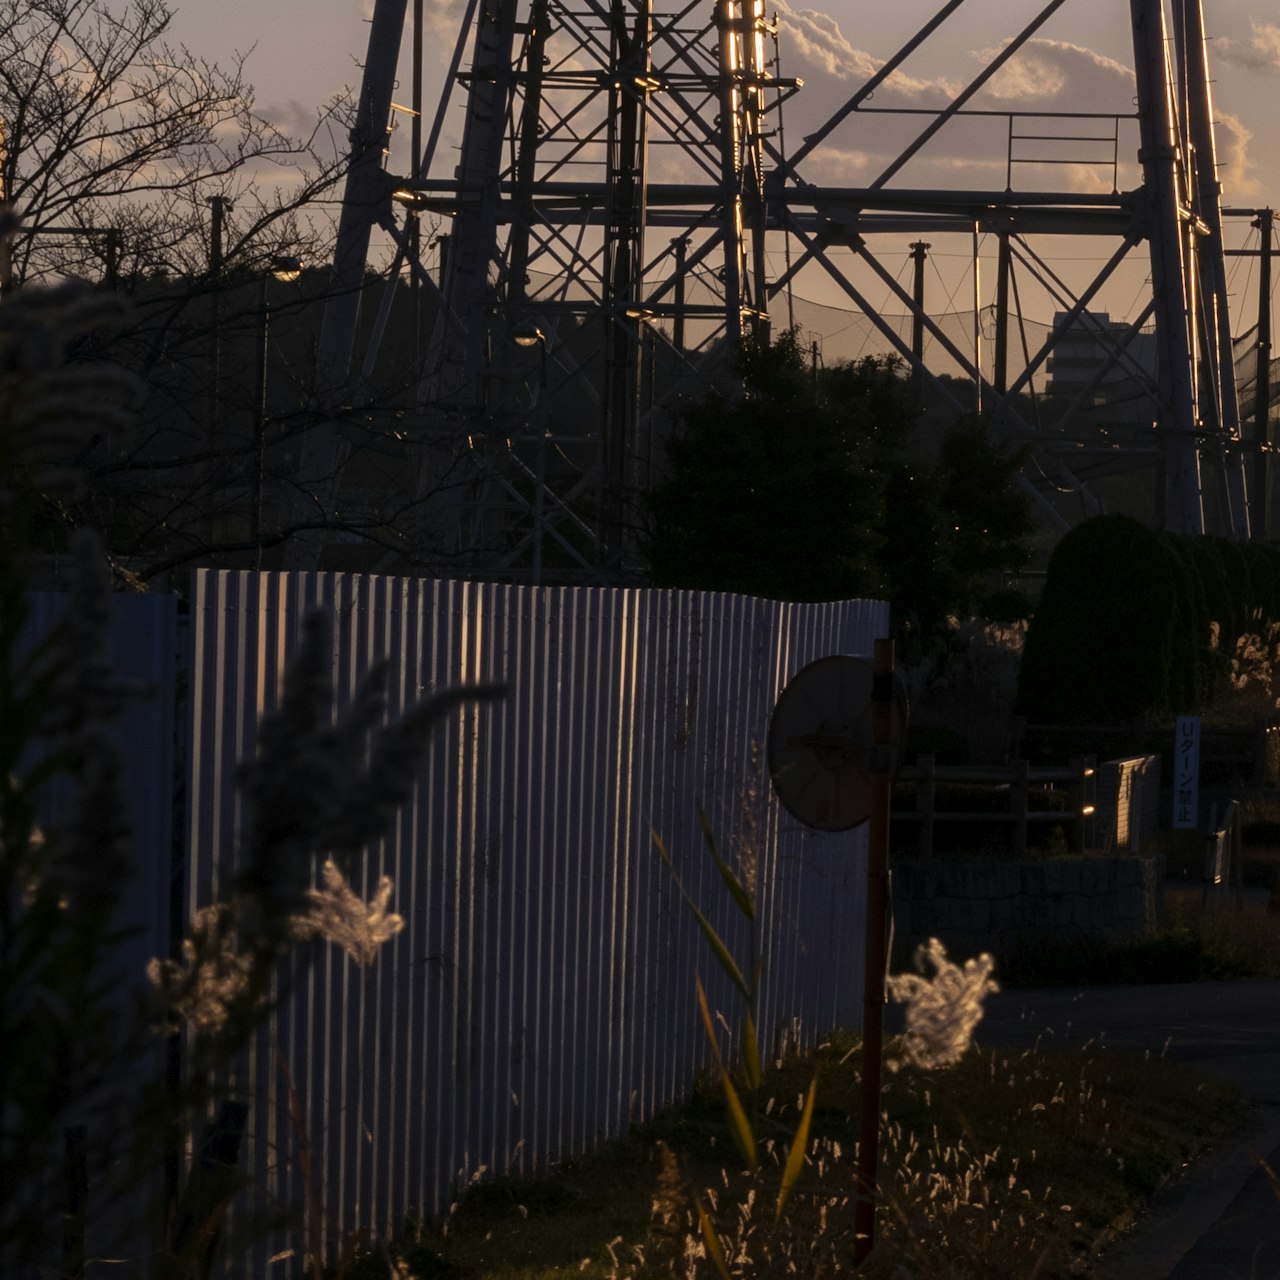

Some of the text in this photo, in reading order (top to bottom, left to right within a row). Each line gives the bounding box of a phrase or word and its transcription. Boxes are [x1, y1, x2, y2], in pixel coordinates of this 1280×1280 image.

[1177, 721, 1193, 822] Uターン禁止
